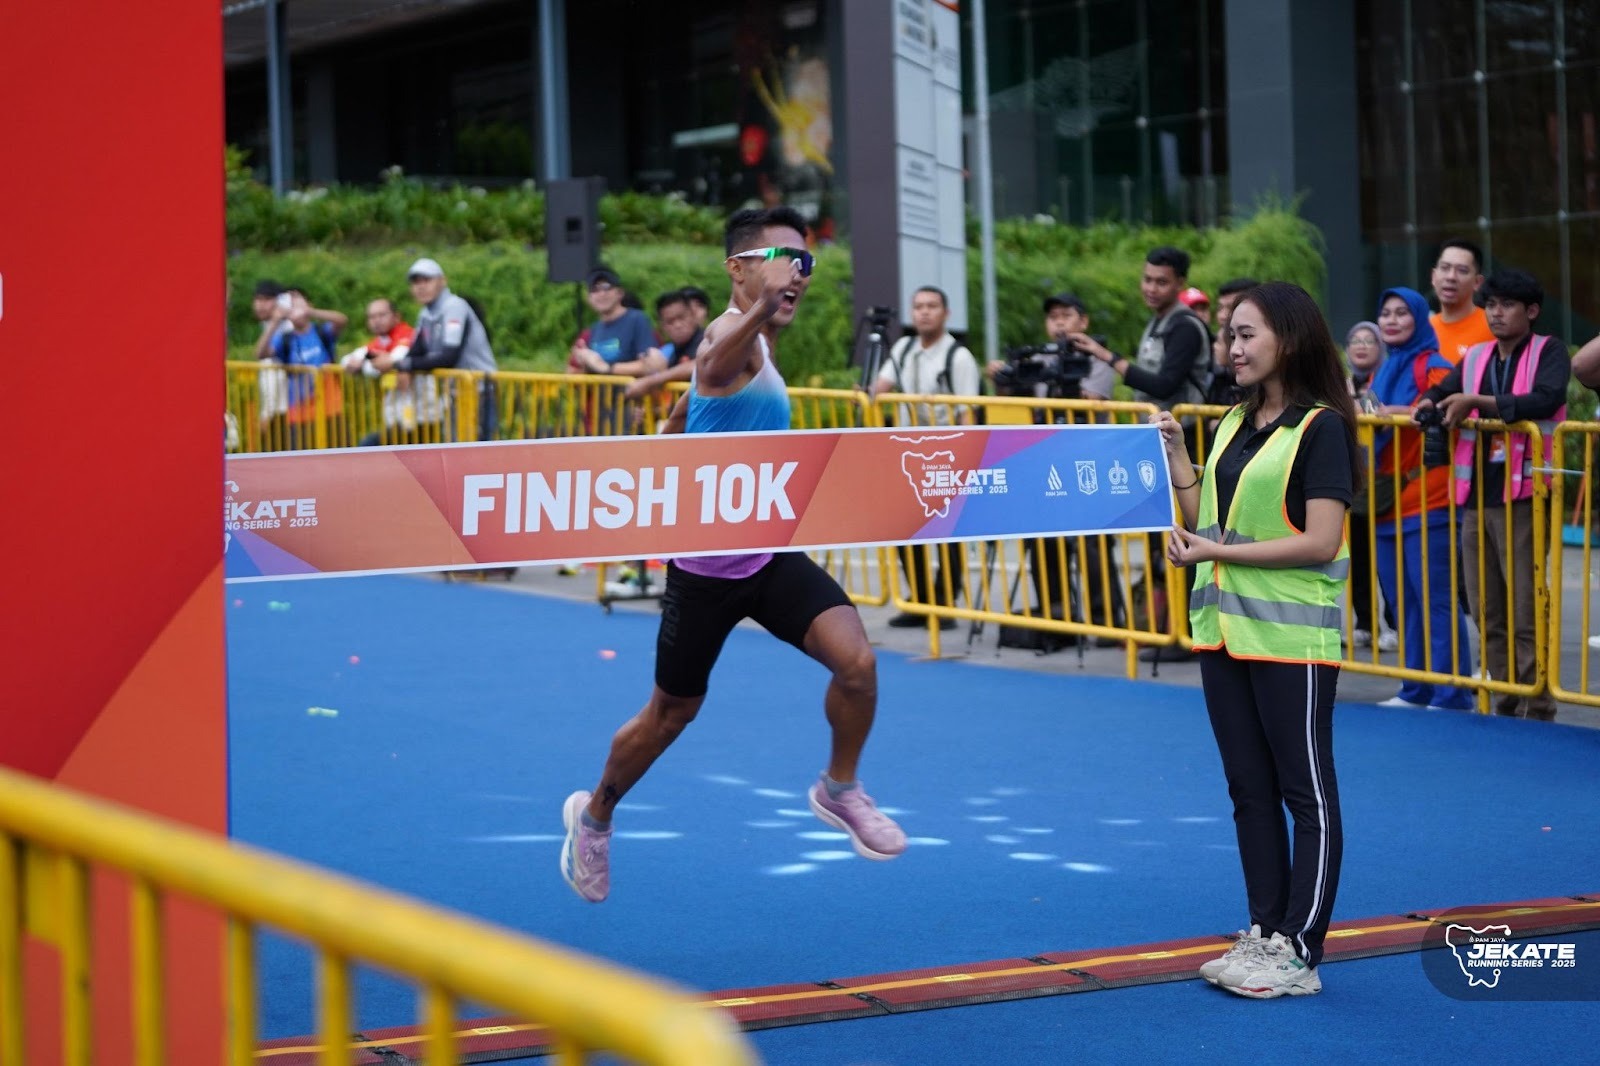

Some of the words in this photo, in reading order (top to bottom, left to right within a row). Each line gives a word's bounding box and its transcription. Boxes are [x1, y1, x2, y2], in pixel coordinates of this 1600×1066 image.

[921, 469, 1006, 487] JEKATE
[462, 466, 680, 536] FINISH
[695, 461, 799, 524] 10K
[922, 487, 957, 497] RUNNING
[958, 486, 984, 496] SERIES
[989, 485, 1008, 494] 2025
[243, 519, 280, 530] SERIES
[289, 517, 319, 528] 2025
